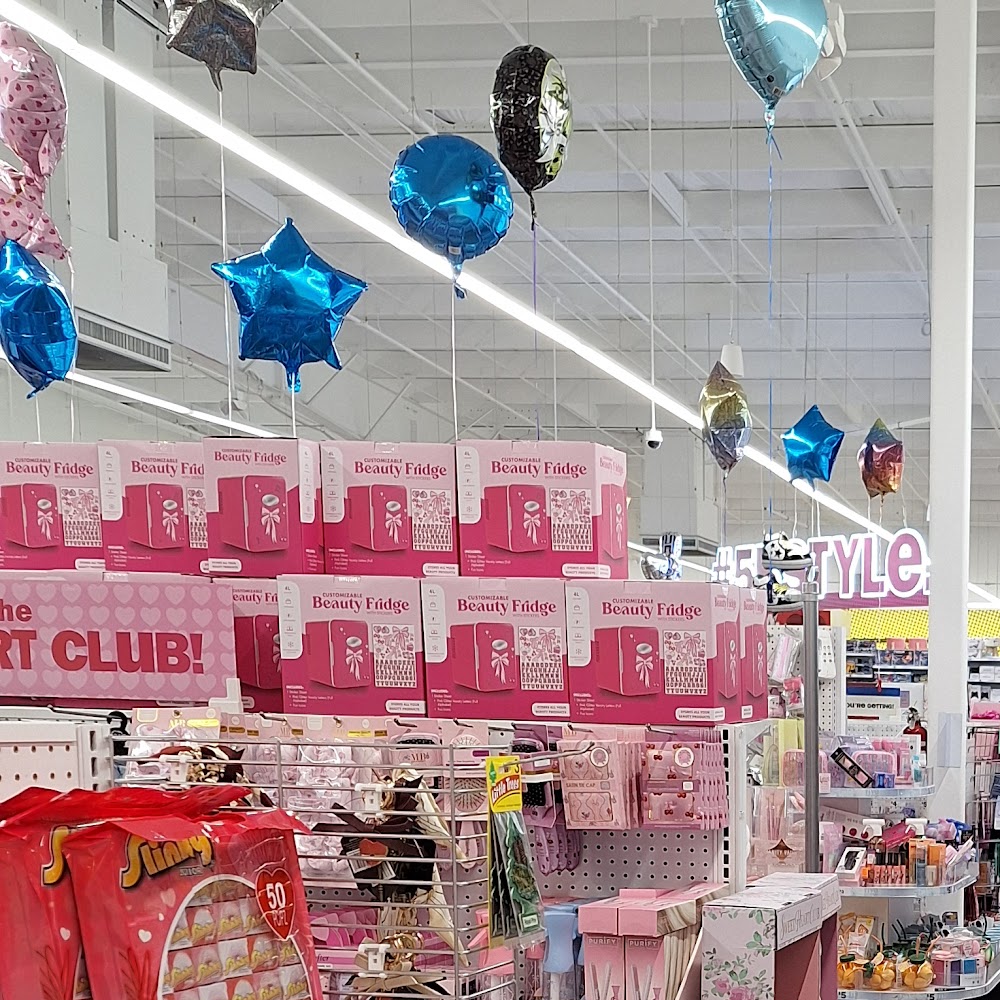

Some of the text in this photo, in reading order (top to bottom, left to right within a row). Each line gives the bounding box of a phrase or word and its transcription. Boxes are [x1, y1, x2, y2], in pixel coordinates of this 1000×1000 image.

[214, 451, 287, 468] Beauty Fridge
[6, 461, 94, 478] Beauty Fridge
[131, 461, 205, 478] Beauty Frid
[354, 461, 447, 479] Beauty Fridge
[491, 461, 587, 479] Beauty Fridge
[232, 593, 279, 606] eauty Fri
[312, 596, 410, 614] Beauty Fridge
[457, 599, 557, 617] Beauty Fridge
[0, 598, 32, 622] he
[602, 602, 702, 620] Beauty Fridge
[51, 629, 205, 675] CLUB!
[491, 776, 520, 803] Little Trees
[266, 881, 286, 909] 50
[588, 936, 617, 945] PURIFY
[629, 938, 657, 947] PURIFY
